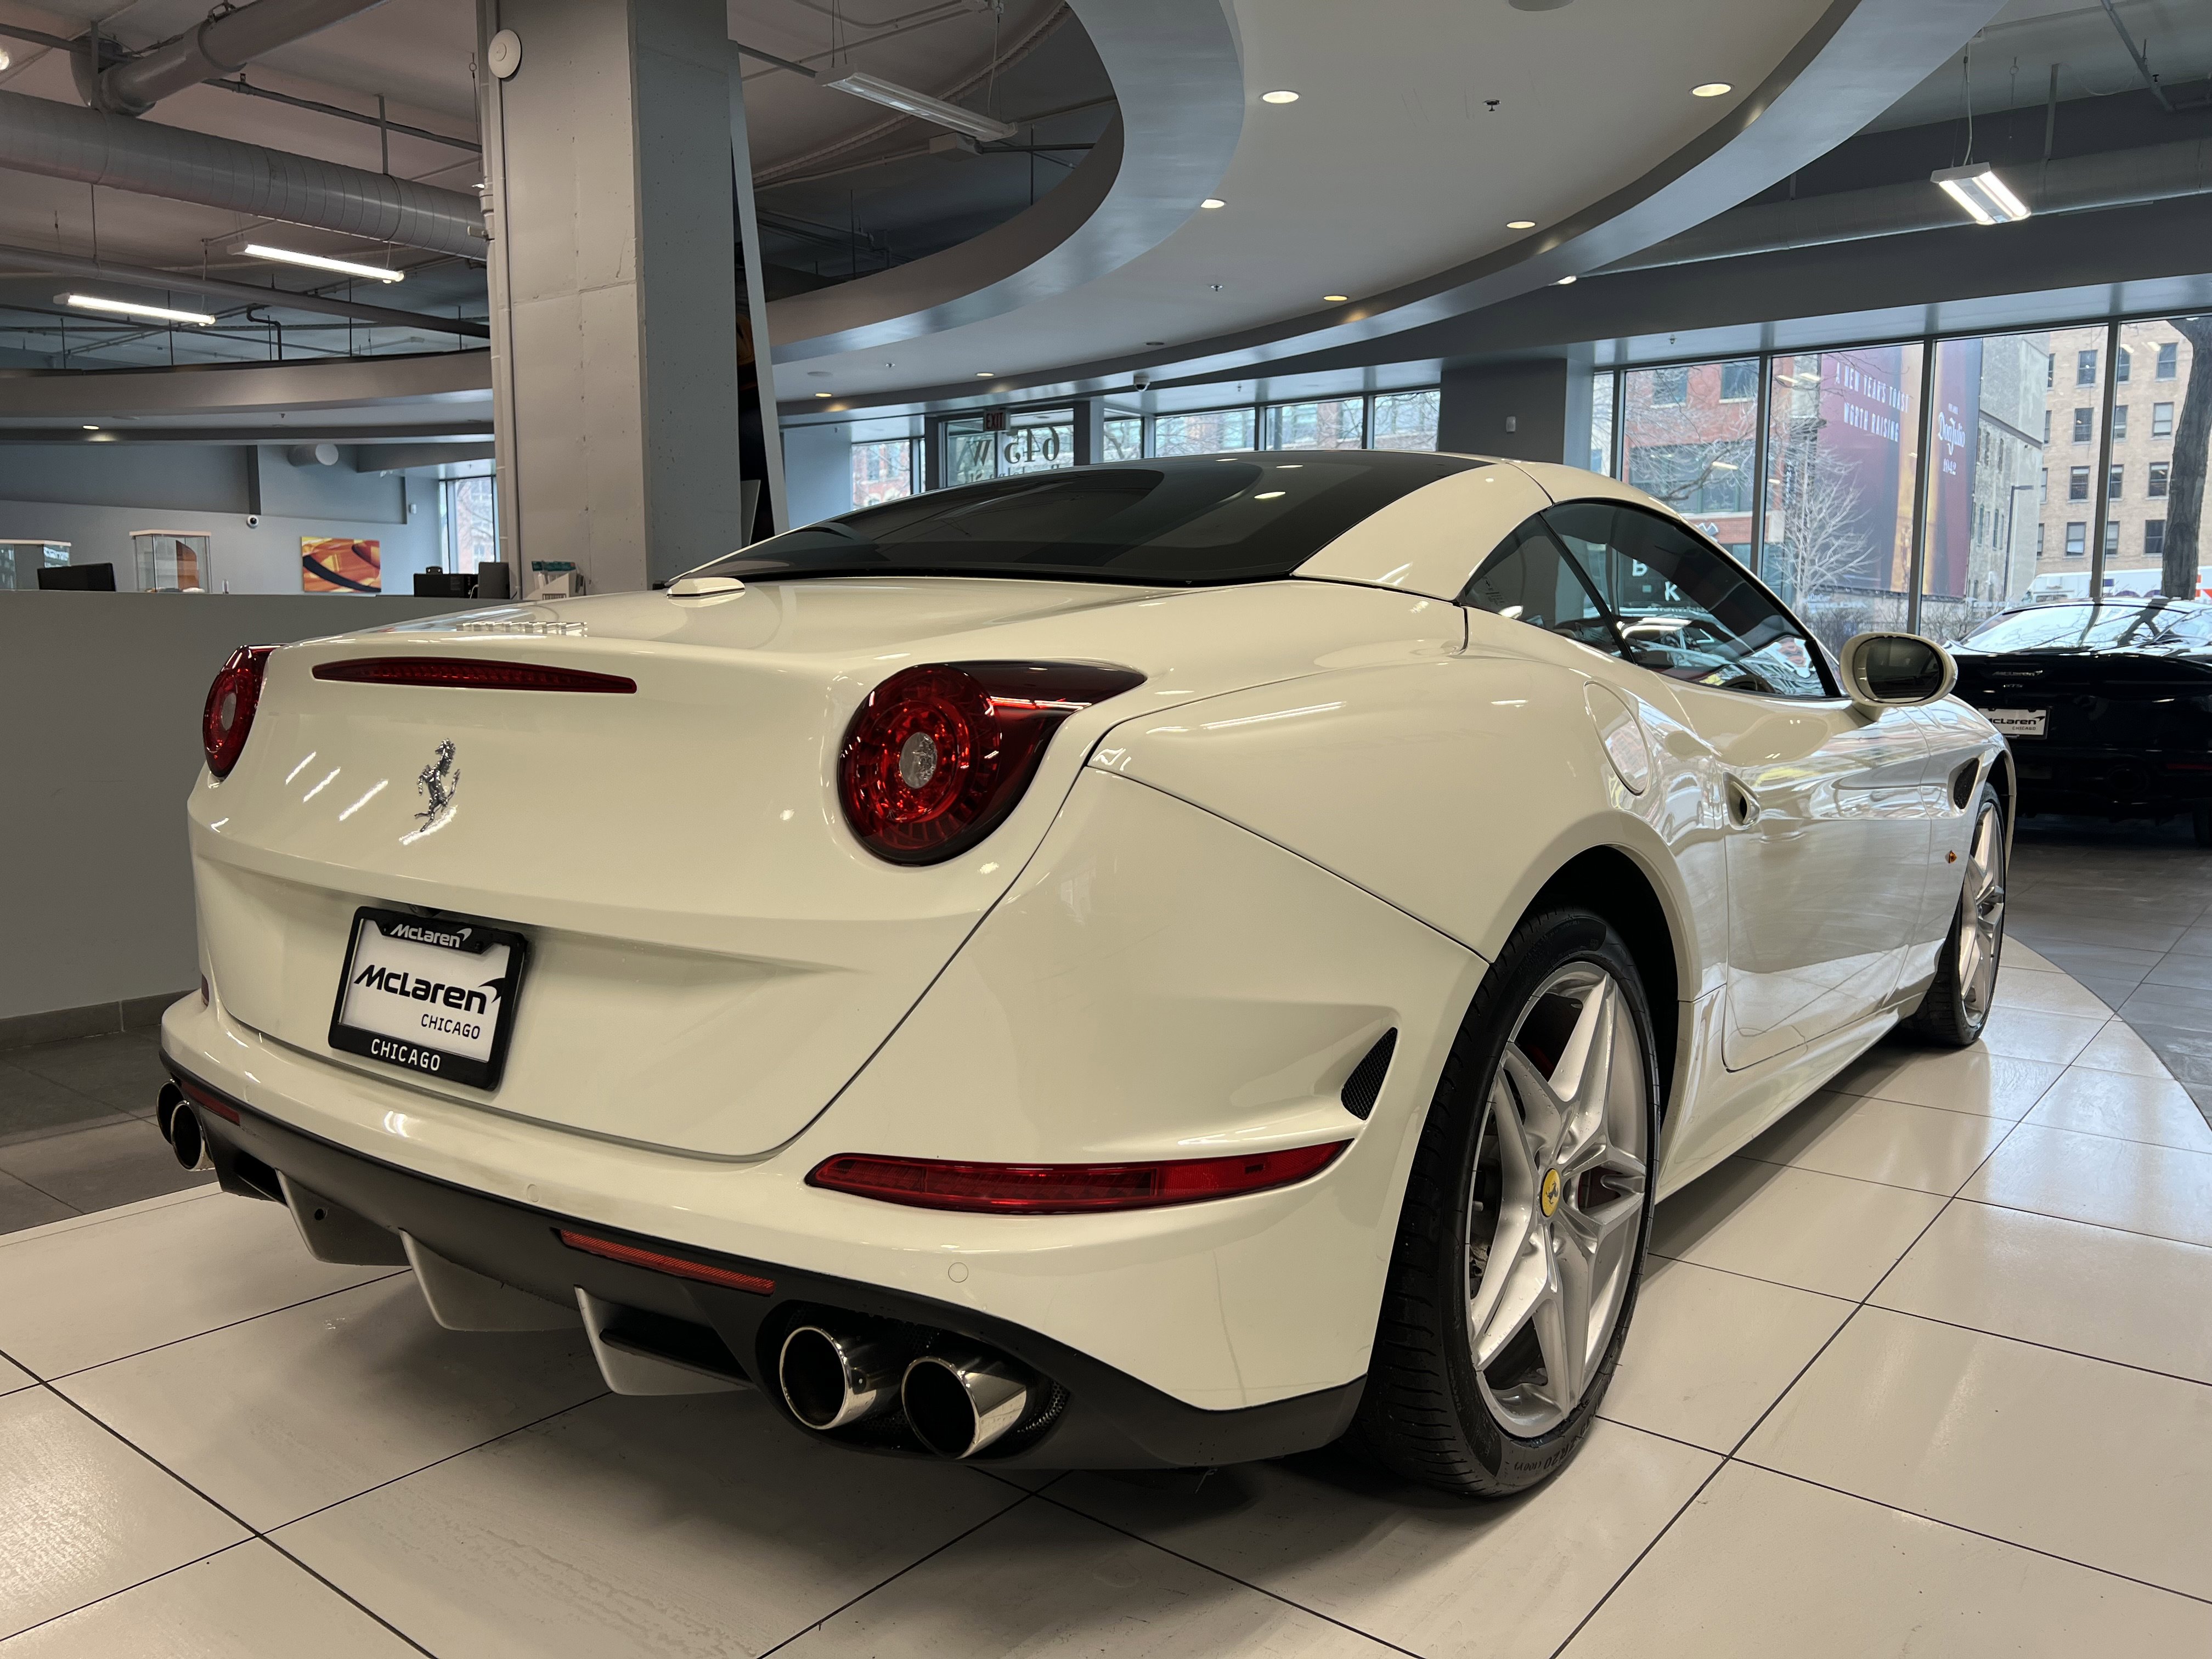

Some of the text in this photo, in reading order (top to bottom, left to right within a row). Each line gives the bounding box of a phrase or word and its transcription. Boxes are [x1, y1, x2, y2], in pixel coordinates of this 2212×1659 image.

[1835, 362, 1840, 384] A
[1889, 386, 1909, 413] TOAST
[986, 413, 1003, 430] EXIT
[1844, 402, 1899, 442] WORTH RAISING
[390, 924, 460, 948] McLaren
[354, 964, 487, 1014] McLaren
[421, 1014, 481, 1040] CHICAGO
[371, 1039, 441, 1071] CHICAGO
